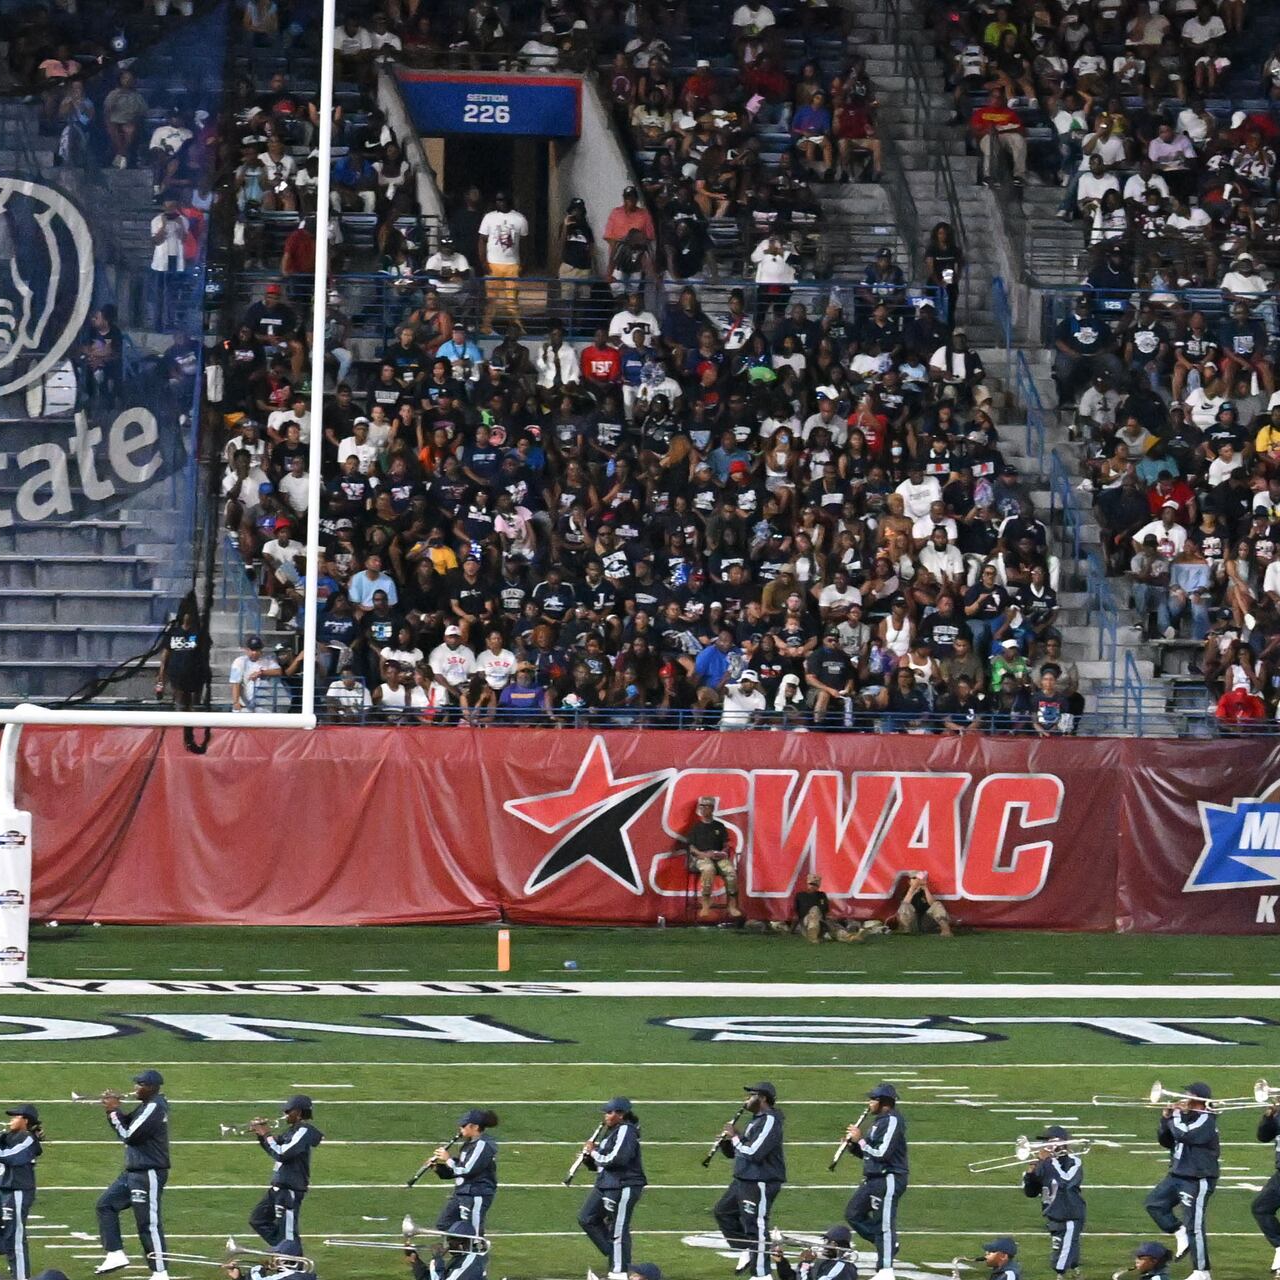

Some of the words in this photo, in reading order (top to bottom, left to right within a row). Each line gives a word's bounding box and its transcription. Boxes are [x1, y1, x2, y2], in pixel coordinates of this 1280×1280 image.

[467, 94, 509, 103] SECTION
[463, 104, 511, 124] 226
[649, 767, 1066, 902] SWAC
[148, 982, 380, 994] NOT
[419, 983, 582, 995] US
